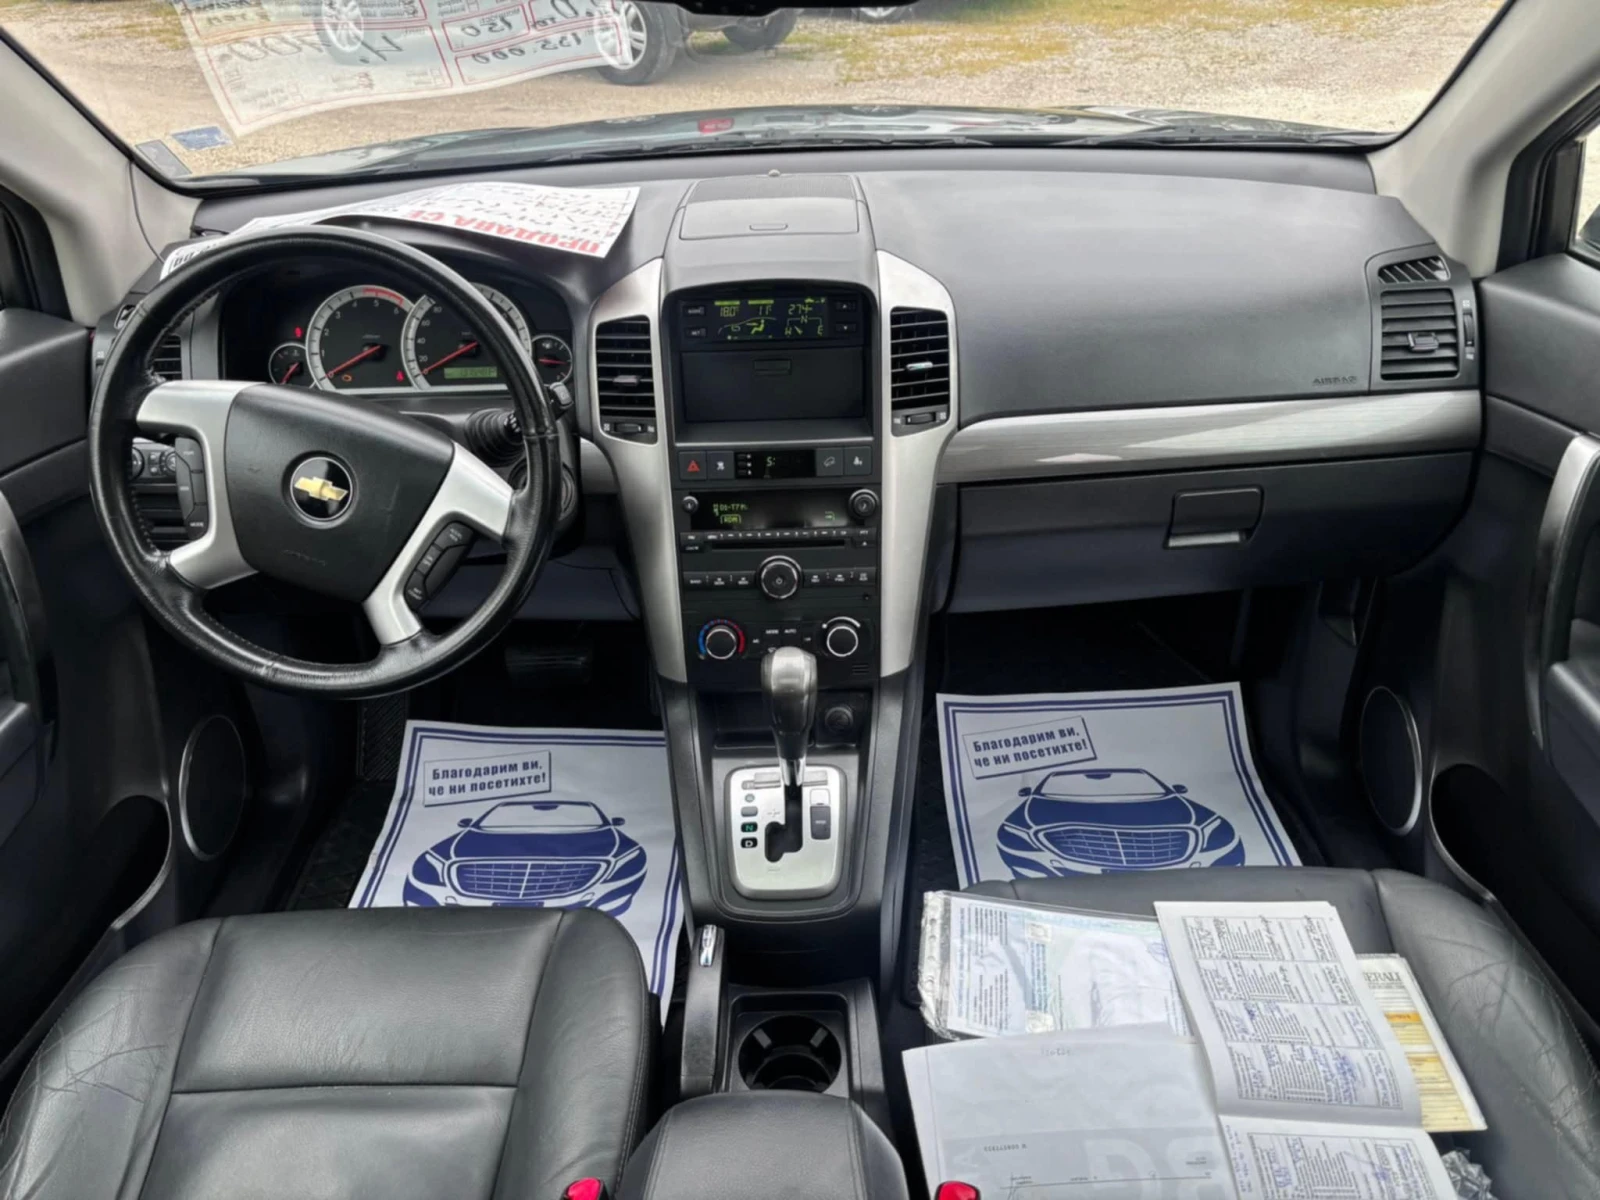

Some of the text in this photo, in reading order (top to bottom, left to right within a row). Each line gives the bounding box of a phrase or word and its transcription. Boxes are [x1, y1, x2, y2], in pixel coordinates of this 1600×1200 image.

[453, 213, 601, 254] ПРОДАВА
[335, 311, 341, 319] 3
[421, 319, 430, 327] 60
[416, 337, 426, 345] 40
[418, 355, 428, 363] 20
[973, 730, 1056, 753] Благодарим
[974, 738, 1088, 769] че ни посетихте!
[432, 761, 518, 780] Благодарим
[428, 772, 546, 797] че ни посетихте!
[745, 824, 754, 832] N
[744, 839, 754, 848] D
